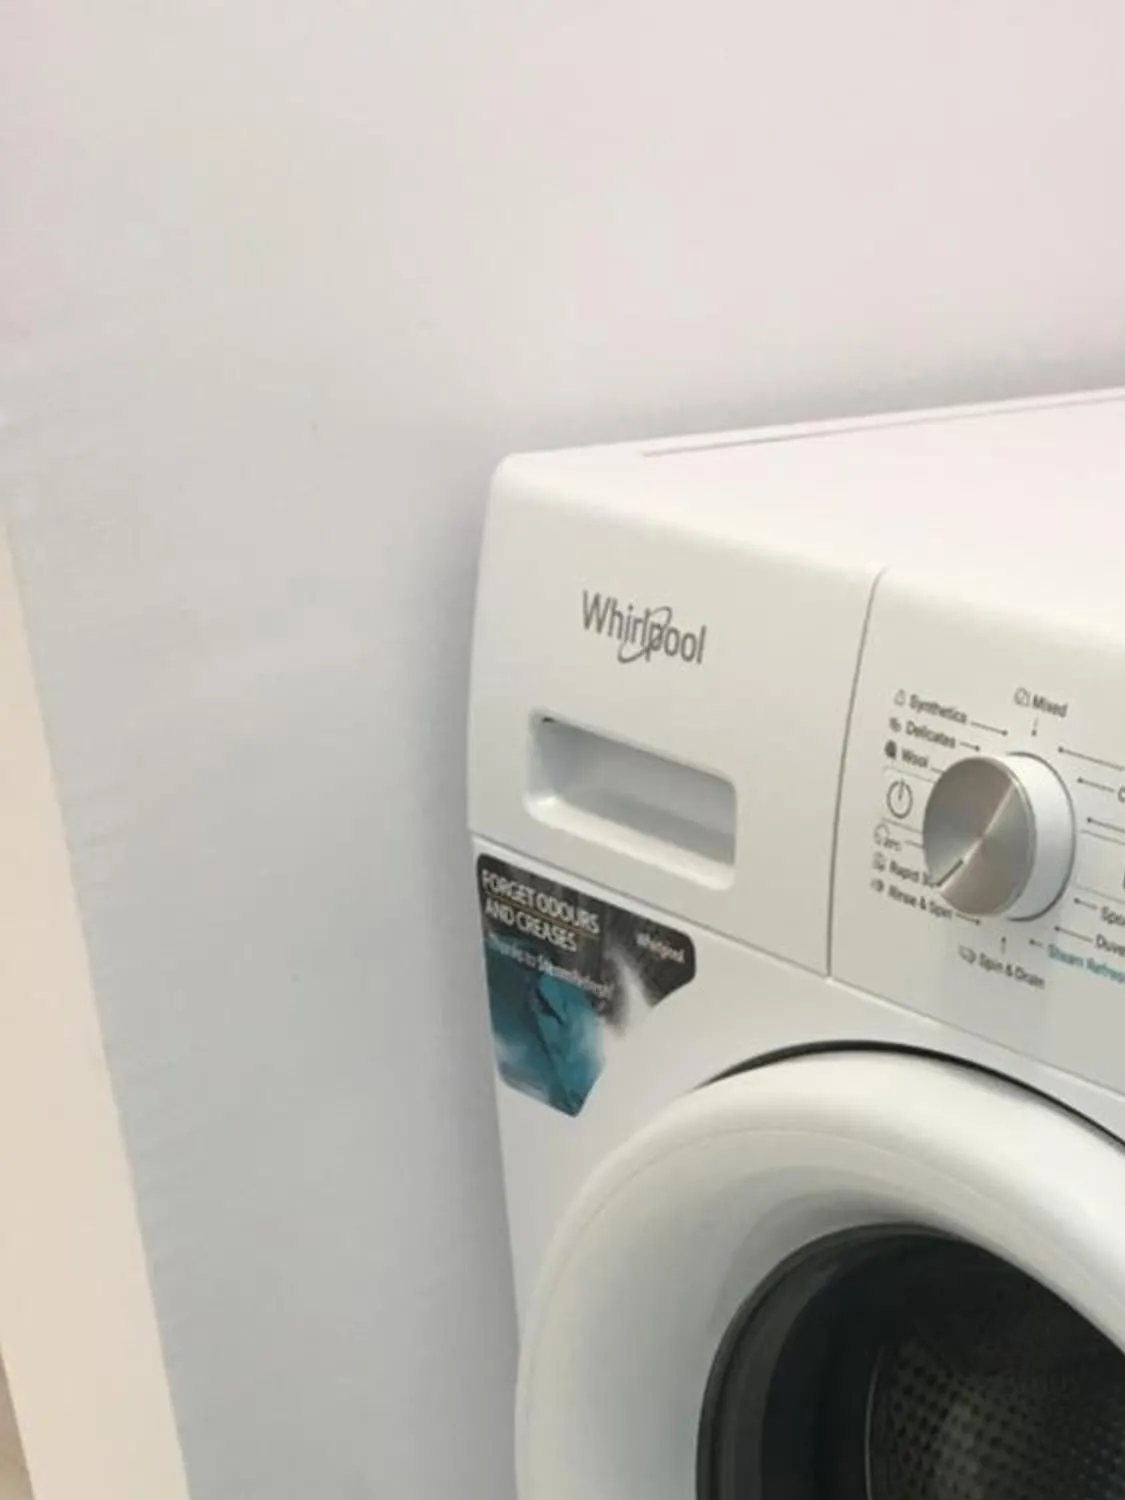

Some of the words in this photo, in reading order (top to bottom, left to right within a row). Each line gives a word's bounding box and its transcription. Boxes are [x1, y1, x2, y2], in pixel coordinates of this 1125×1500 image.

[582, 589, 706, 664] Whirlpool
[909, 694, 967, 724] Synthetics
[1032, 694, 1067, 717] Mixed
[905, 720, 955, 748] Delicates
[482, 869, 536, 908] FORGET
[535, 892, 600, 934] ODOURS
[485, 898, 514, 926] AND
